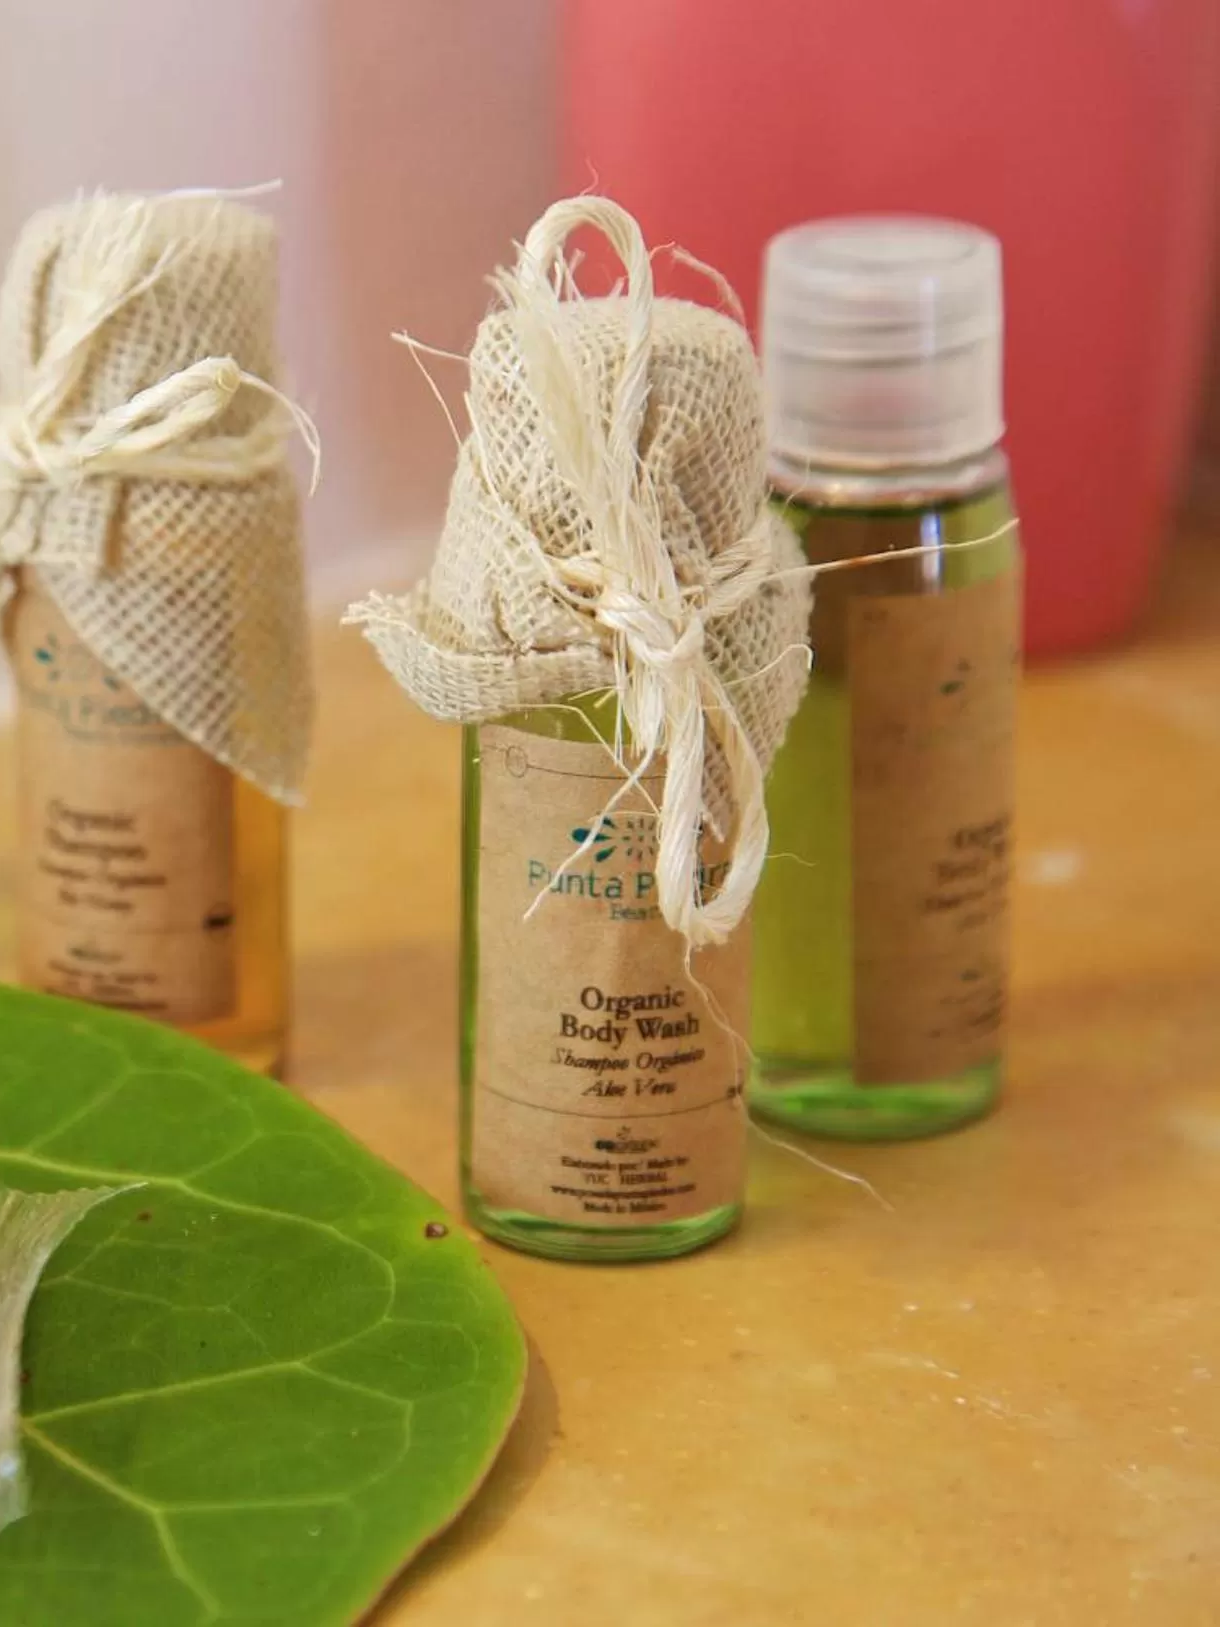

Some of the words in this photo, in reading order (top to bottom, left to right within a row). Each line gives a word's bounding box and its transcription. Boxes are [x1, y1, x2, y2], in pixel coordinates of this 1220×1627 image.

[528, 860, 623, 899] Punta
[581, 985, 685, 1020] Organic
[560, 1013, 627, 1049] Body
[635, 1012, 700, 1042] Wash
